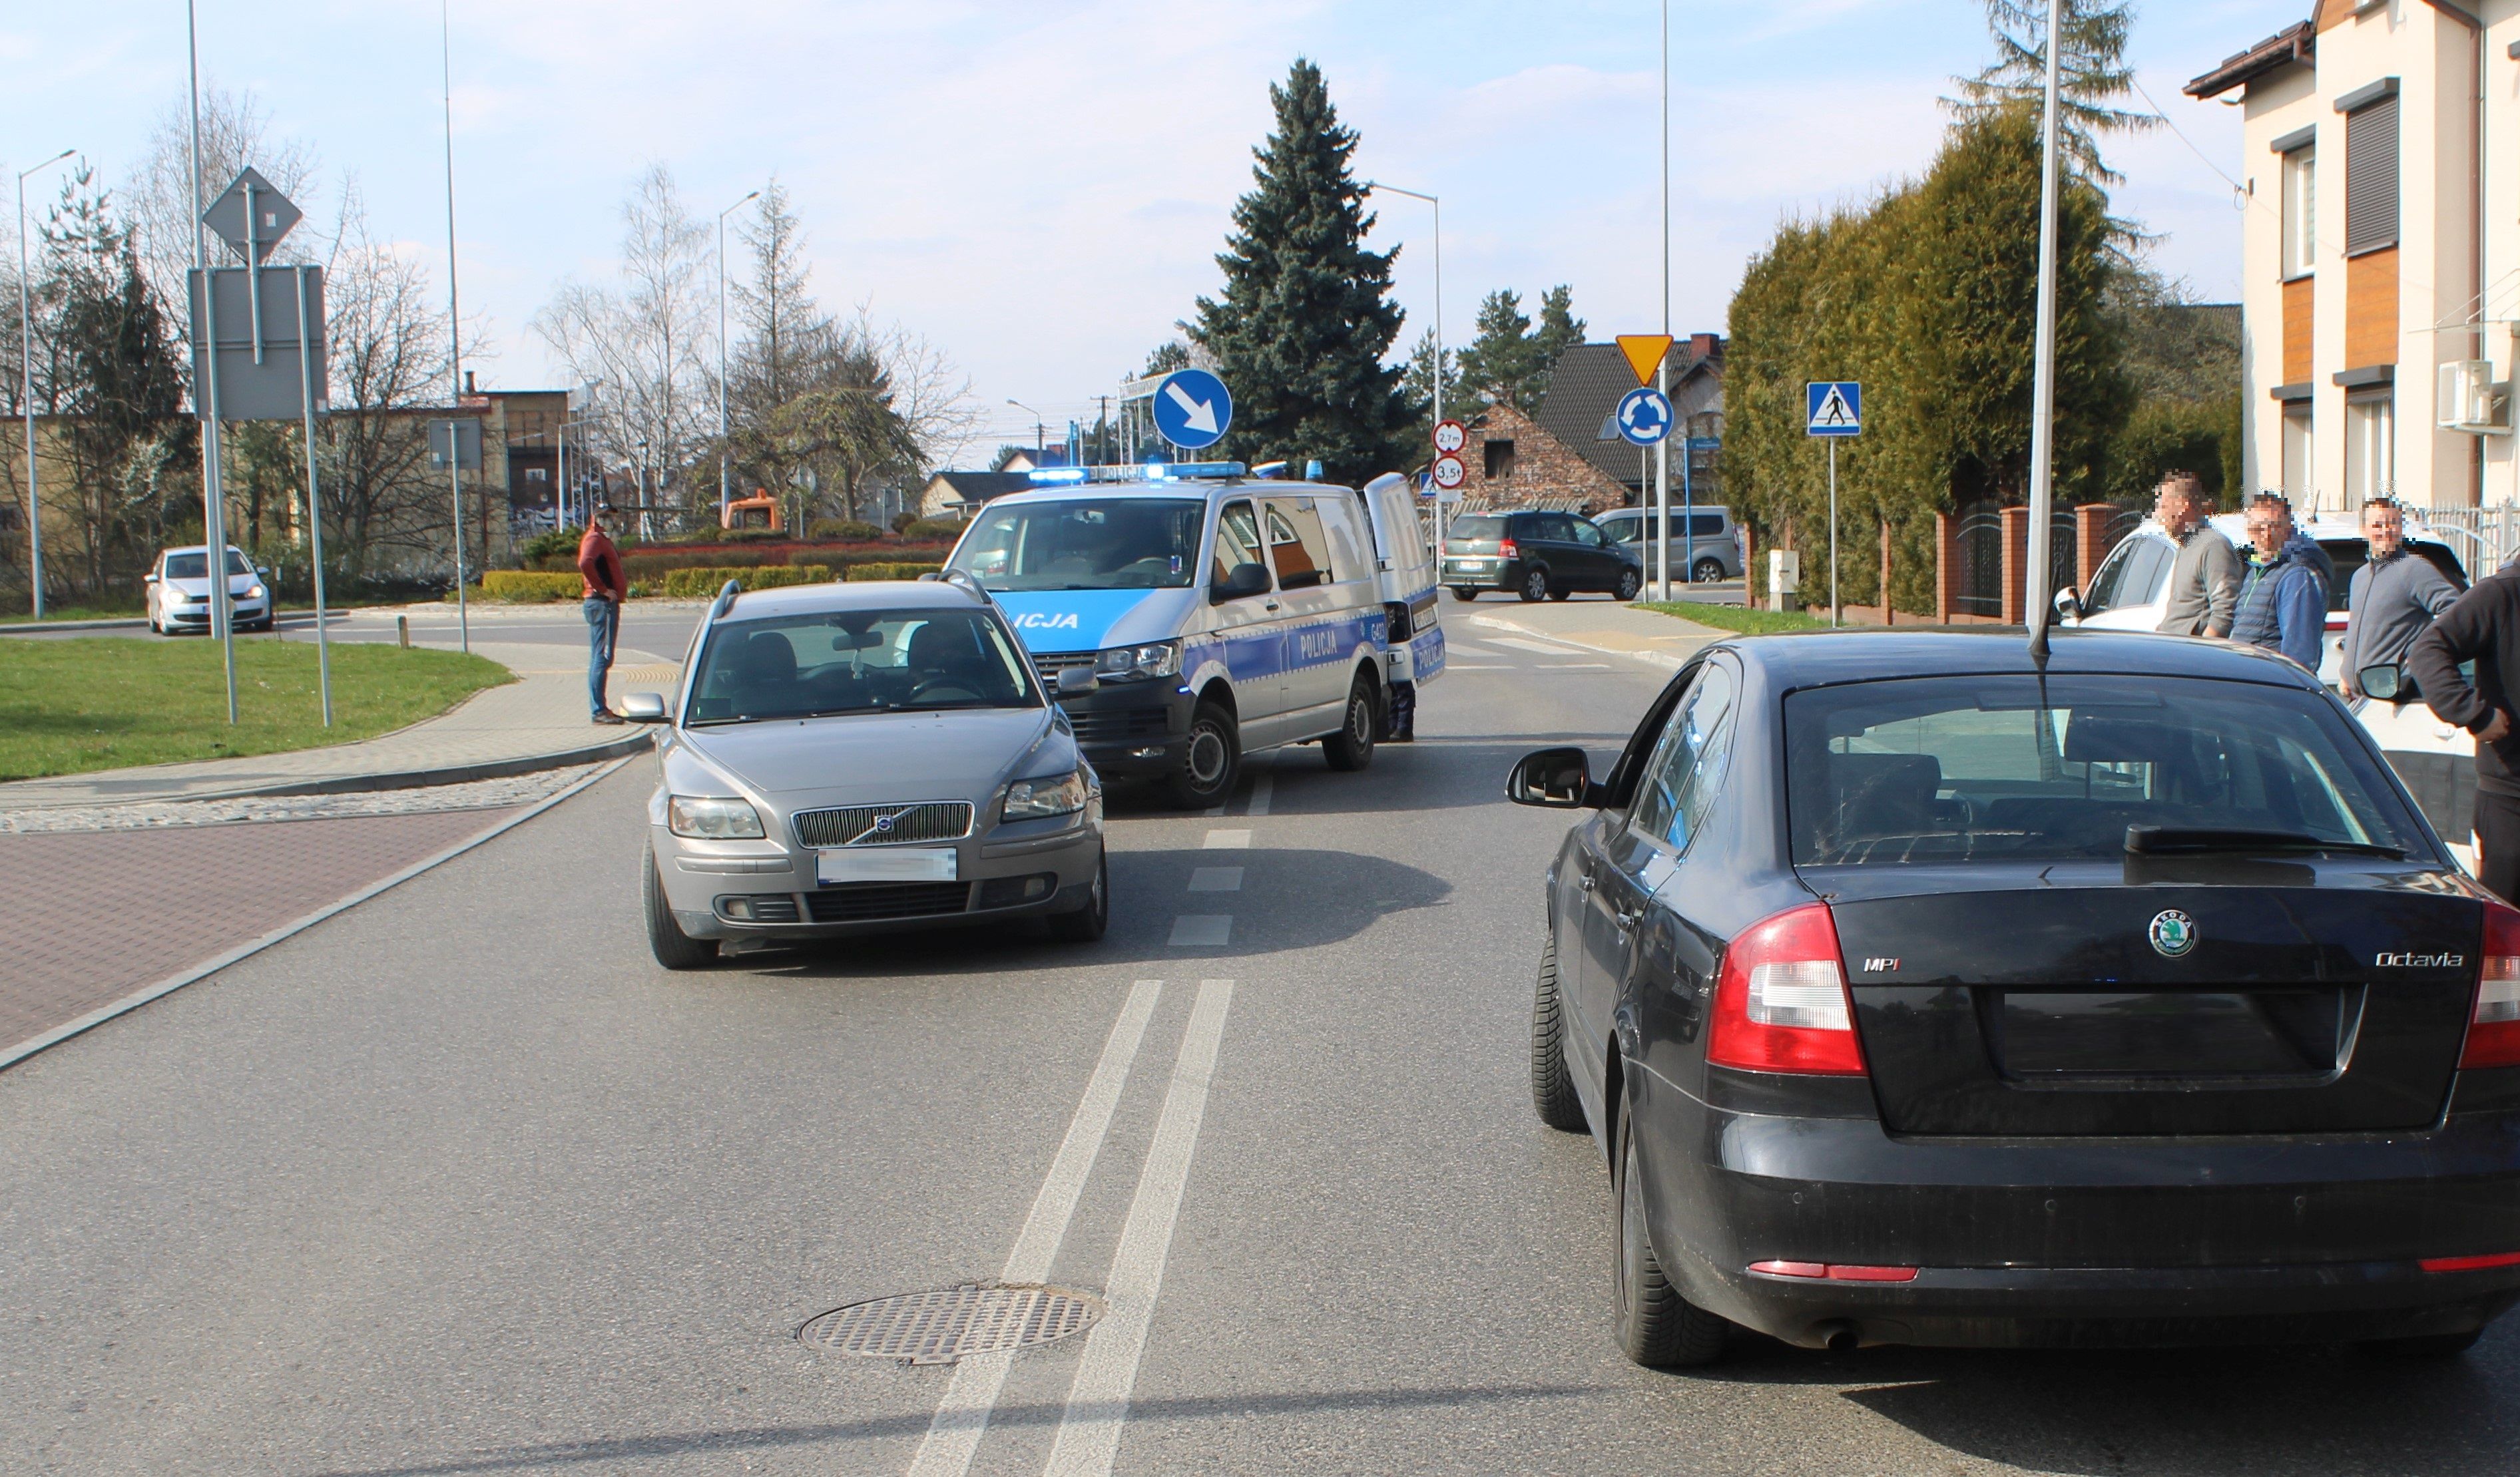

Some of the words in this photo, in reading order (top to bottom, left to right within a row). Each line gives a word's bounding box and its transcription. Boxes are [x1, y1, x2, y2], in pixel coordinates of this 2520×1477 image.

[1013, 613, 1079, 628] ICJA
[1300, 630, 1338, 660] POLICJA
[1864, 958, 1901, 972] MPI
[2376, 952, 2463, 967] Octavia
